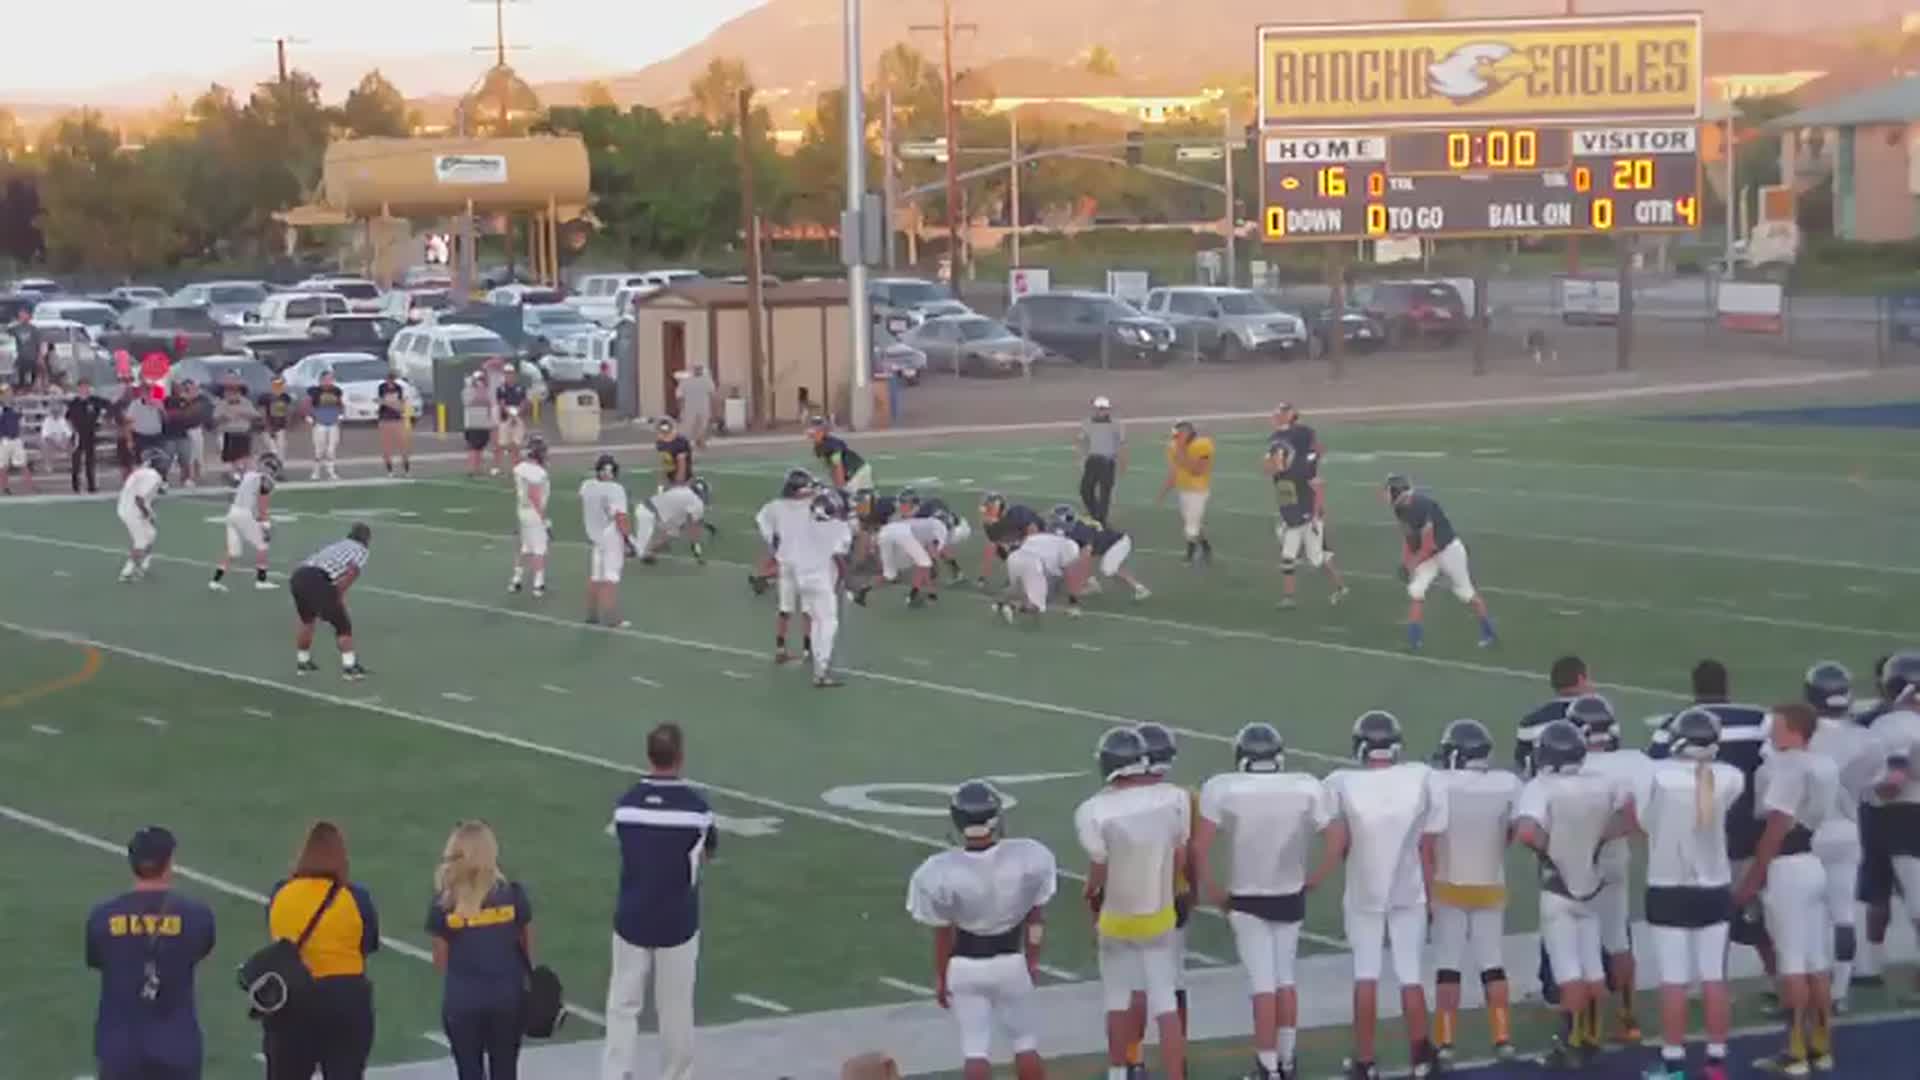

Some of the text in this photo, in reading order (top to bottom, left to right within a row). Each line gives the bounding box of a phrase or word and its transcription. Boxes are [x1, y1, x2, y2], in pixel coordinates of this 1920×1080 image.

[1275, 40, 1689, 104] RANCHO EAGLES
[1279, 140, 1371, 158] HOME
[1448, 130, 1537, 168] 0:00
[1582, 131, 1688, 149] VISITOR
[1318, 166, 1346, 197] 16
[1575, 167, 1591, 192] 0
[1613, 159, 1653, 190] 20
[1266, 206, 1285, 237] 0
[1287, 208, 1342, 232] DOWN
[1367, 203, 1386, 236] 0
[1388, 205, 1443, 230] TO GO
[1489, 202, 1572, 227] BALL ON
[1592, 198, 1613, 229] 0
[1675, 197, 1696, 225] 4
